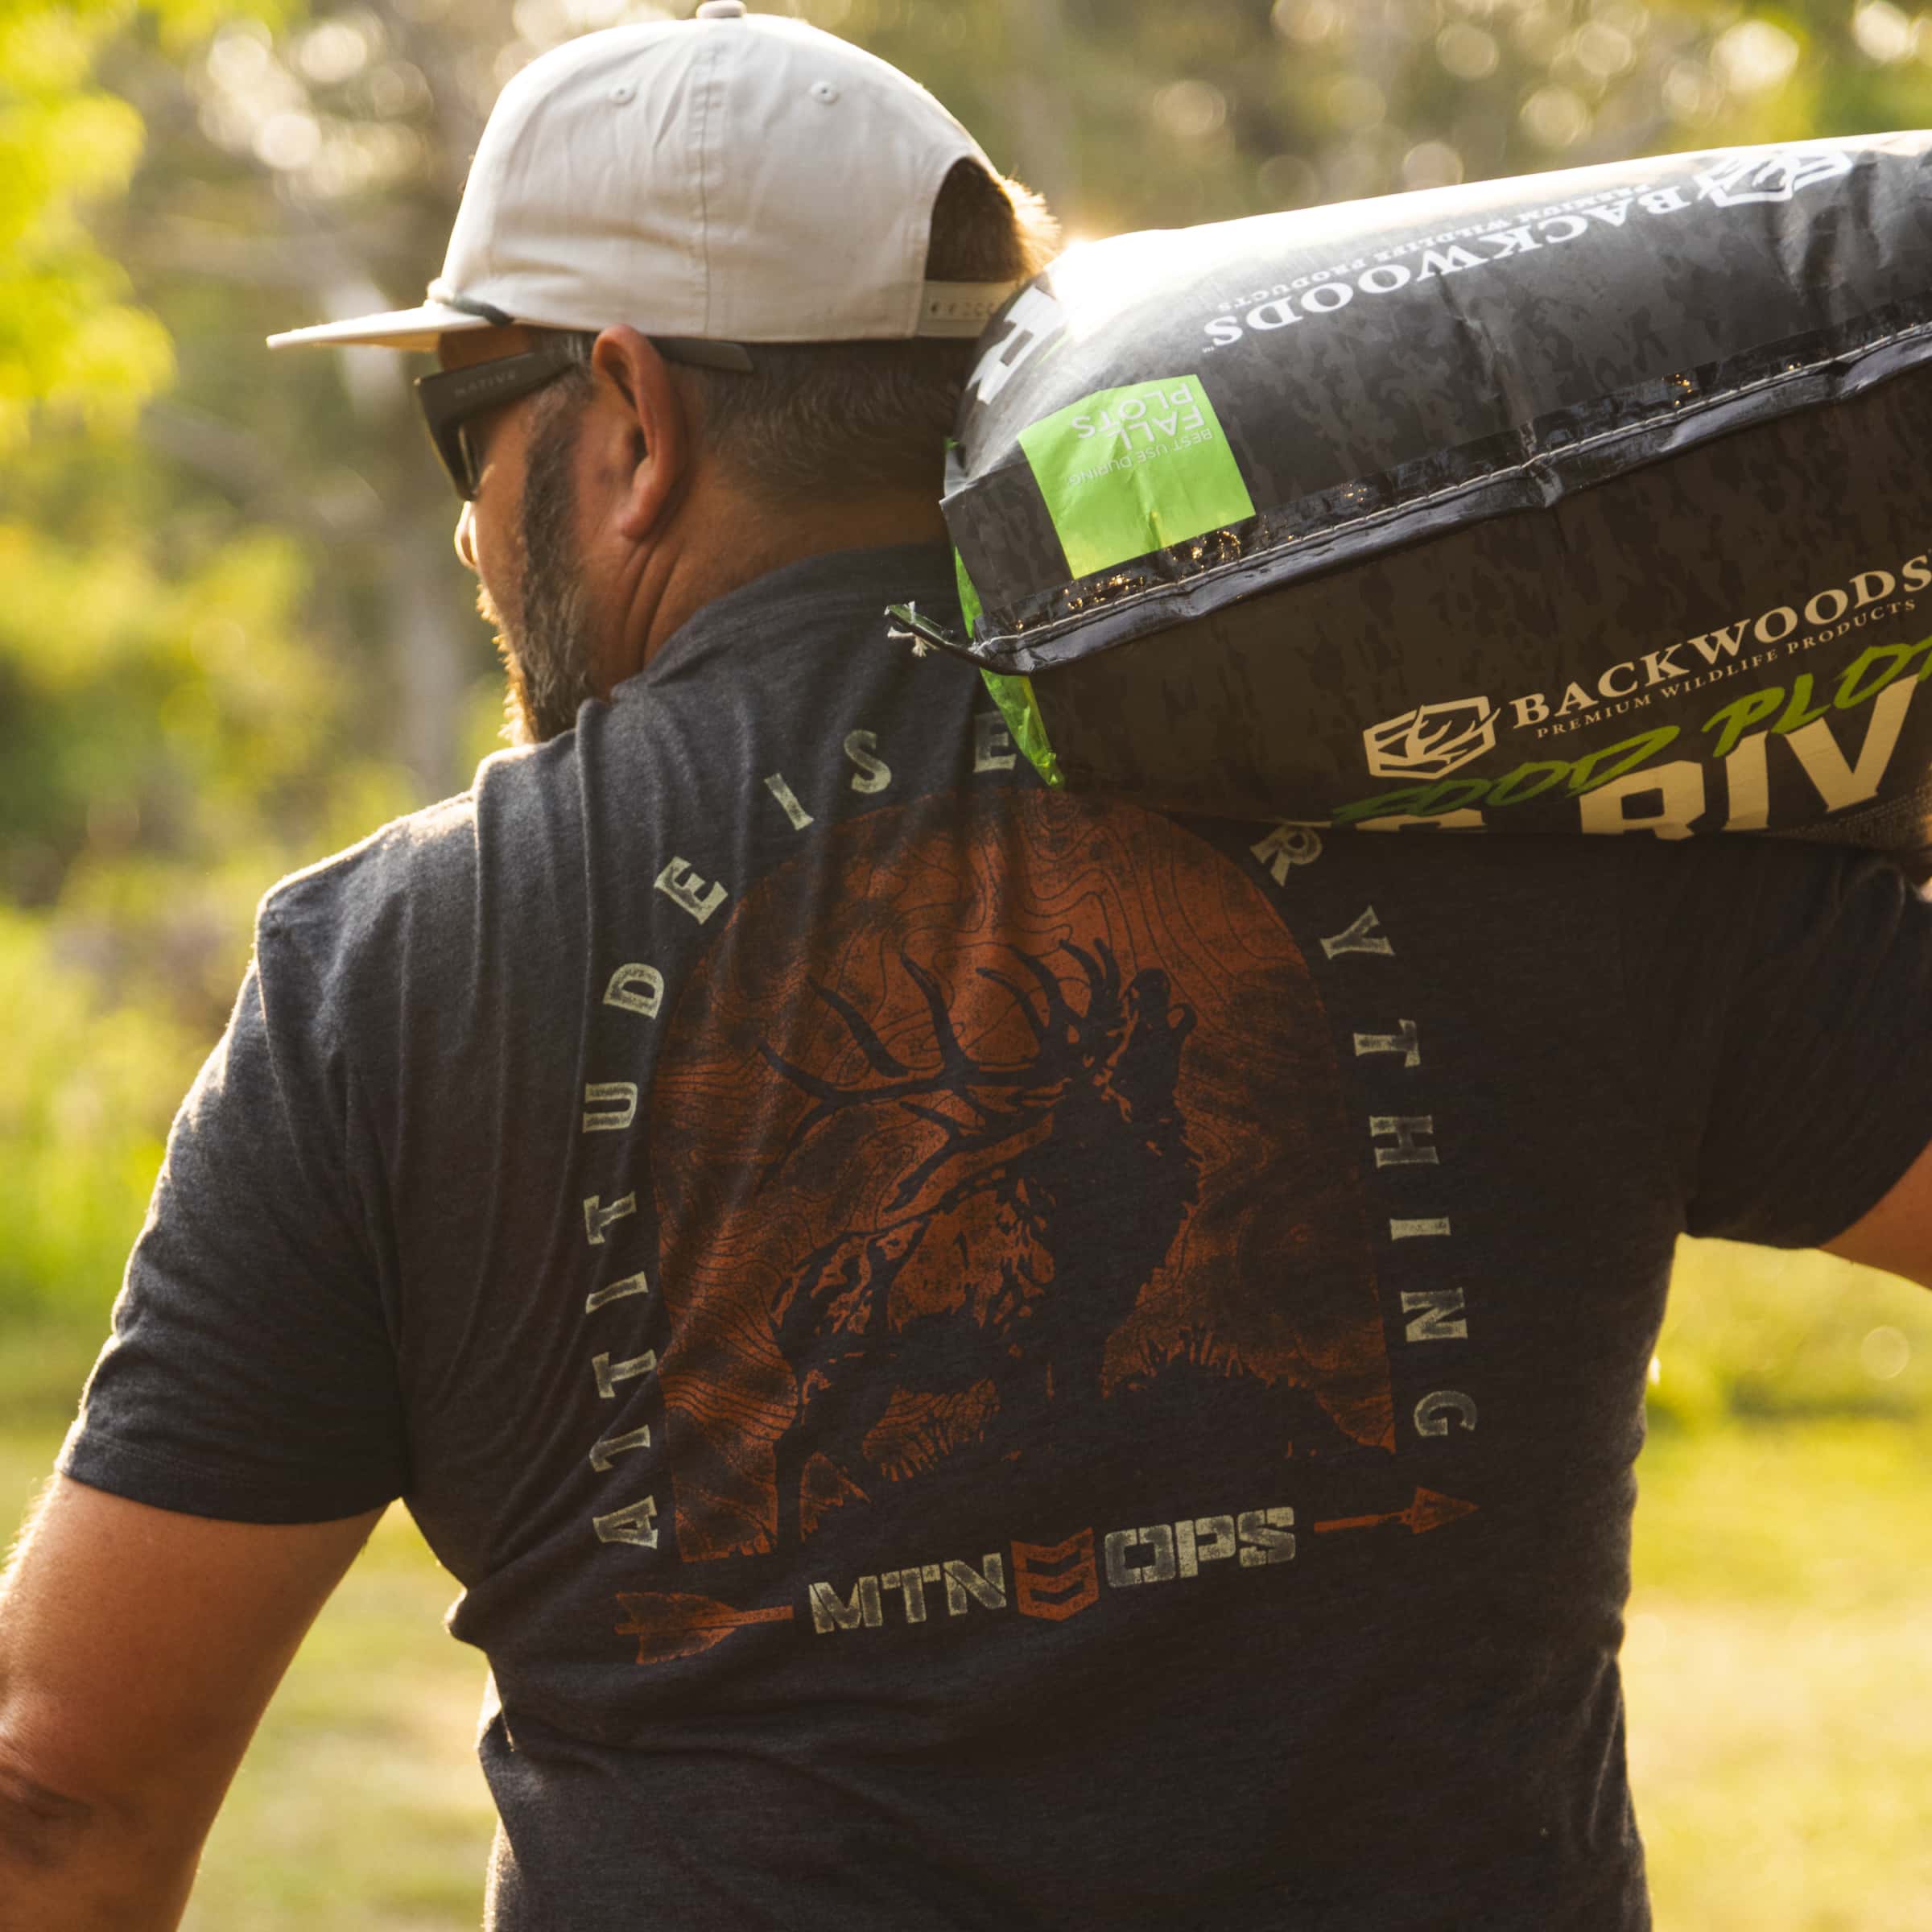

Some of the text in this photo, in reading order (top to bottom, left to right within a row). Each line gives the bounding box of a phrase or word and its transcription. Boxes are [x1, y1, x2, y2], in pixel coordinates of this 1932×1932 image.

[1203, 186, 1691, 347] BACKWOODS
[1218, 258, 1368, 313] PRODUCTS
[1373, 217, 1513, 262] WILDLIFE
[1069, 428, 1212, 485] BEST USE DURING
[1071, 382, 1194, 439] PLOTS
[1108, 405, 1205, 451] FALL
[1509, 555, 1932, 729] BACKWOODS
[1536, 599, 1916, 739] PREMIUM WILDLIFE PRODUCTS
[583, 857, 728, 1549] ATTITUDE
[764, 729, 891, 830] IS
[809, 1506, 1296, 1634] MTN OPS
